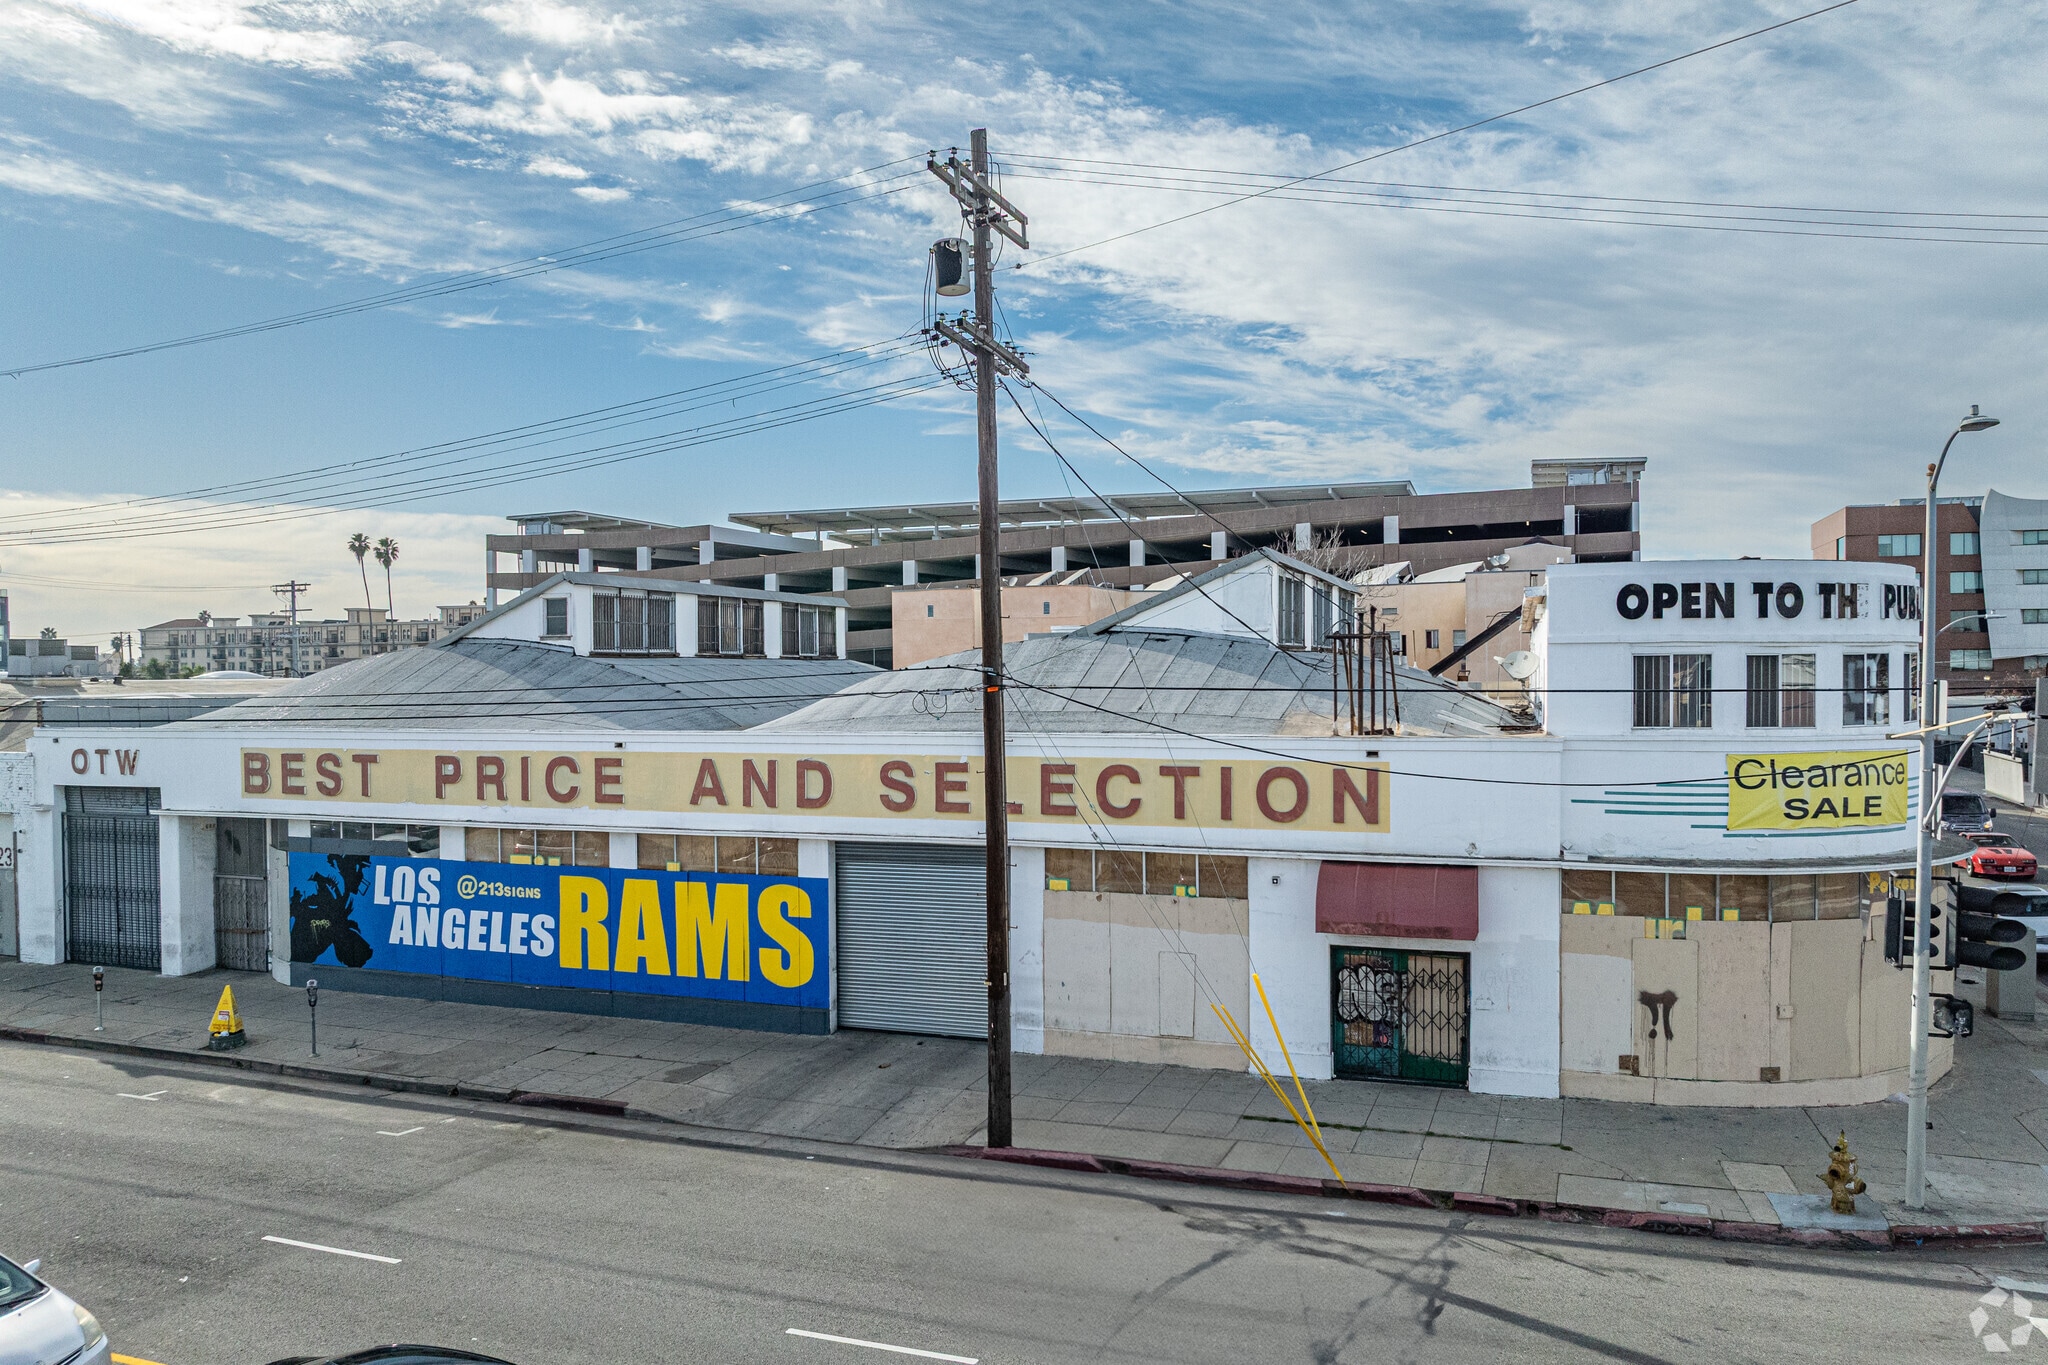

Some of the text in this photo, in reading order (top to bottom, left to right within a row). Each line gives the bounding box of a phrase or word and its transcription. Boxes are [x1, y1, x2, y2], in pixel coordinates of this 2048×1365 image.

[1616, 582, 1735, 620] OPEN
[1751, 581, 1805, 619] TO
[71, 748, 140, 776] OTW
[1733, 758, 1905, 790] Clearance
[244, 753, 1380, 825] BEST PRICE AND SEECTION
[1783, 795, 1882, 820] SALE
[374, 865, 441, 905] LOS
[457, 874, 541, 899] @213SIGNS
[389, 905, 556, 957] ANGELES
[559, 875, 814, 989] RAMS
